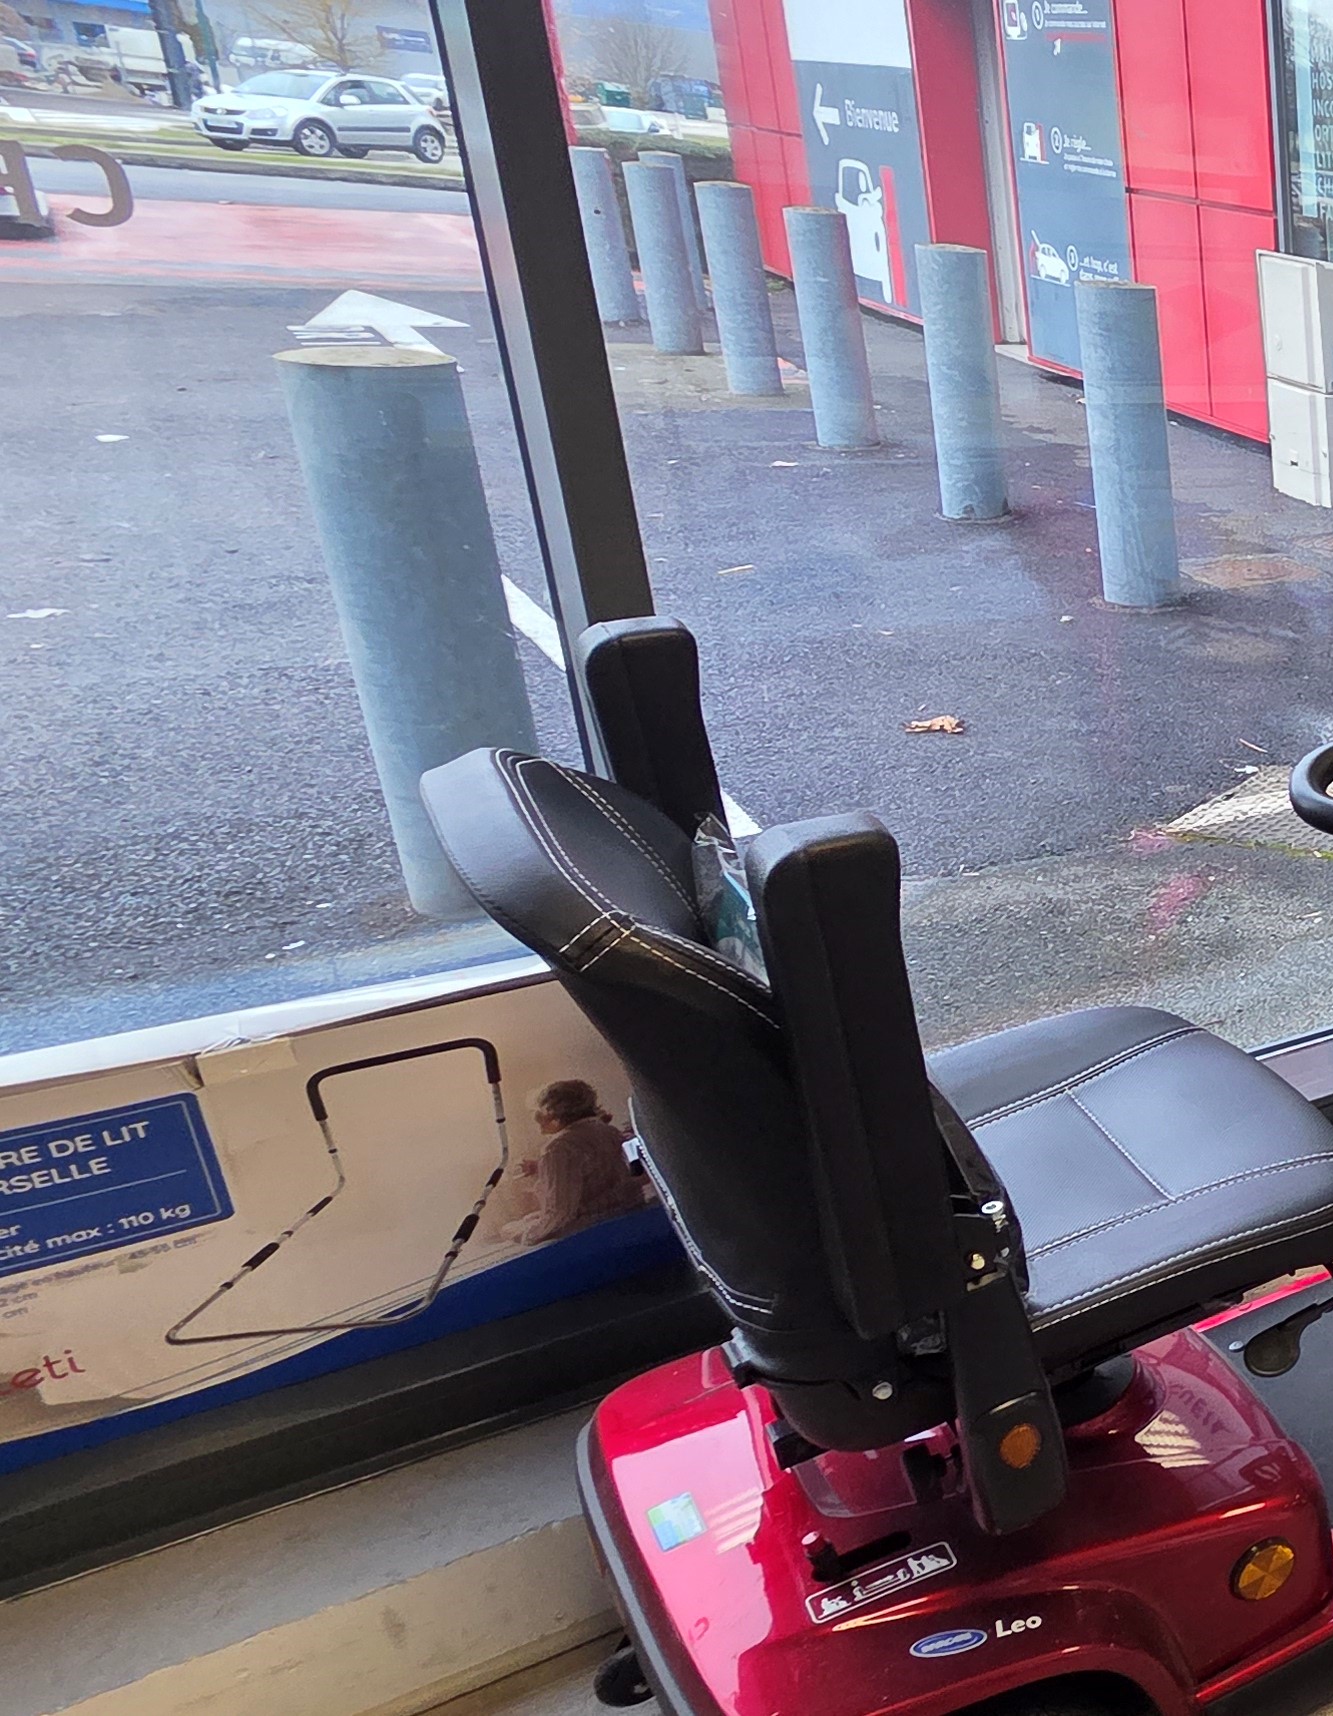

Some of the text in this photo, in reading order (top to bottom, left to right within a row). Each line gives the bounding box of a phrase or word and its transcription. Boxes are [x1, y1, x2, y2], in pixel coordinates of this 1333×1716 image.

[844, 98, 899, 133] Bienvenue
[47, 1134, 97, 1158] DE
[102, 1120, 150, 1147] LIT
[45, 1226, 102, 1249] max
[118, 1212, 155, 1230] 110
[160, 1203, 192, 1221] kg
[995, 1615, 1043, 1638] Leo
